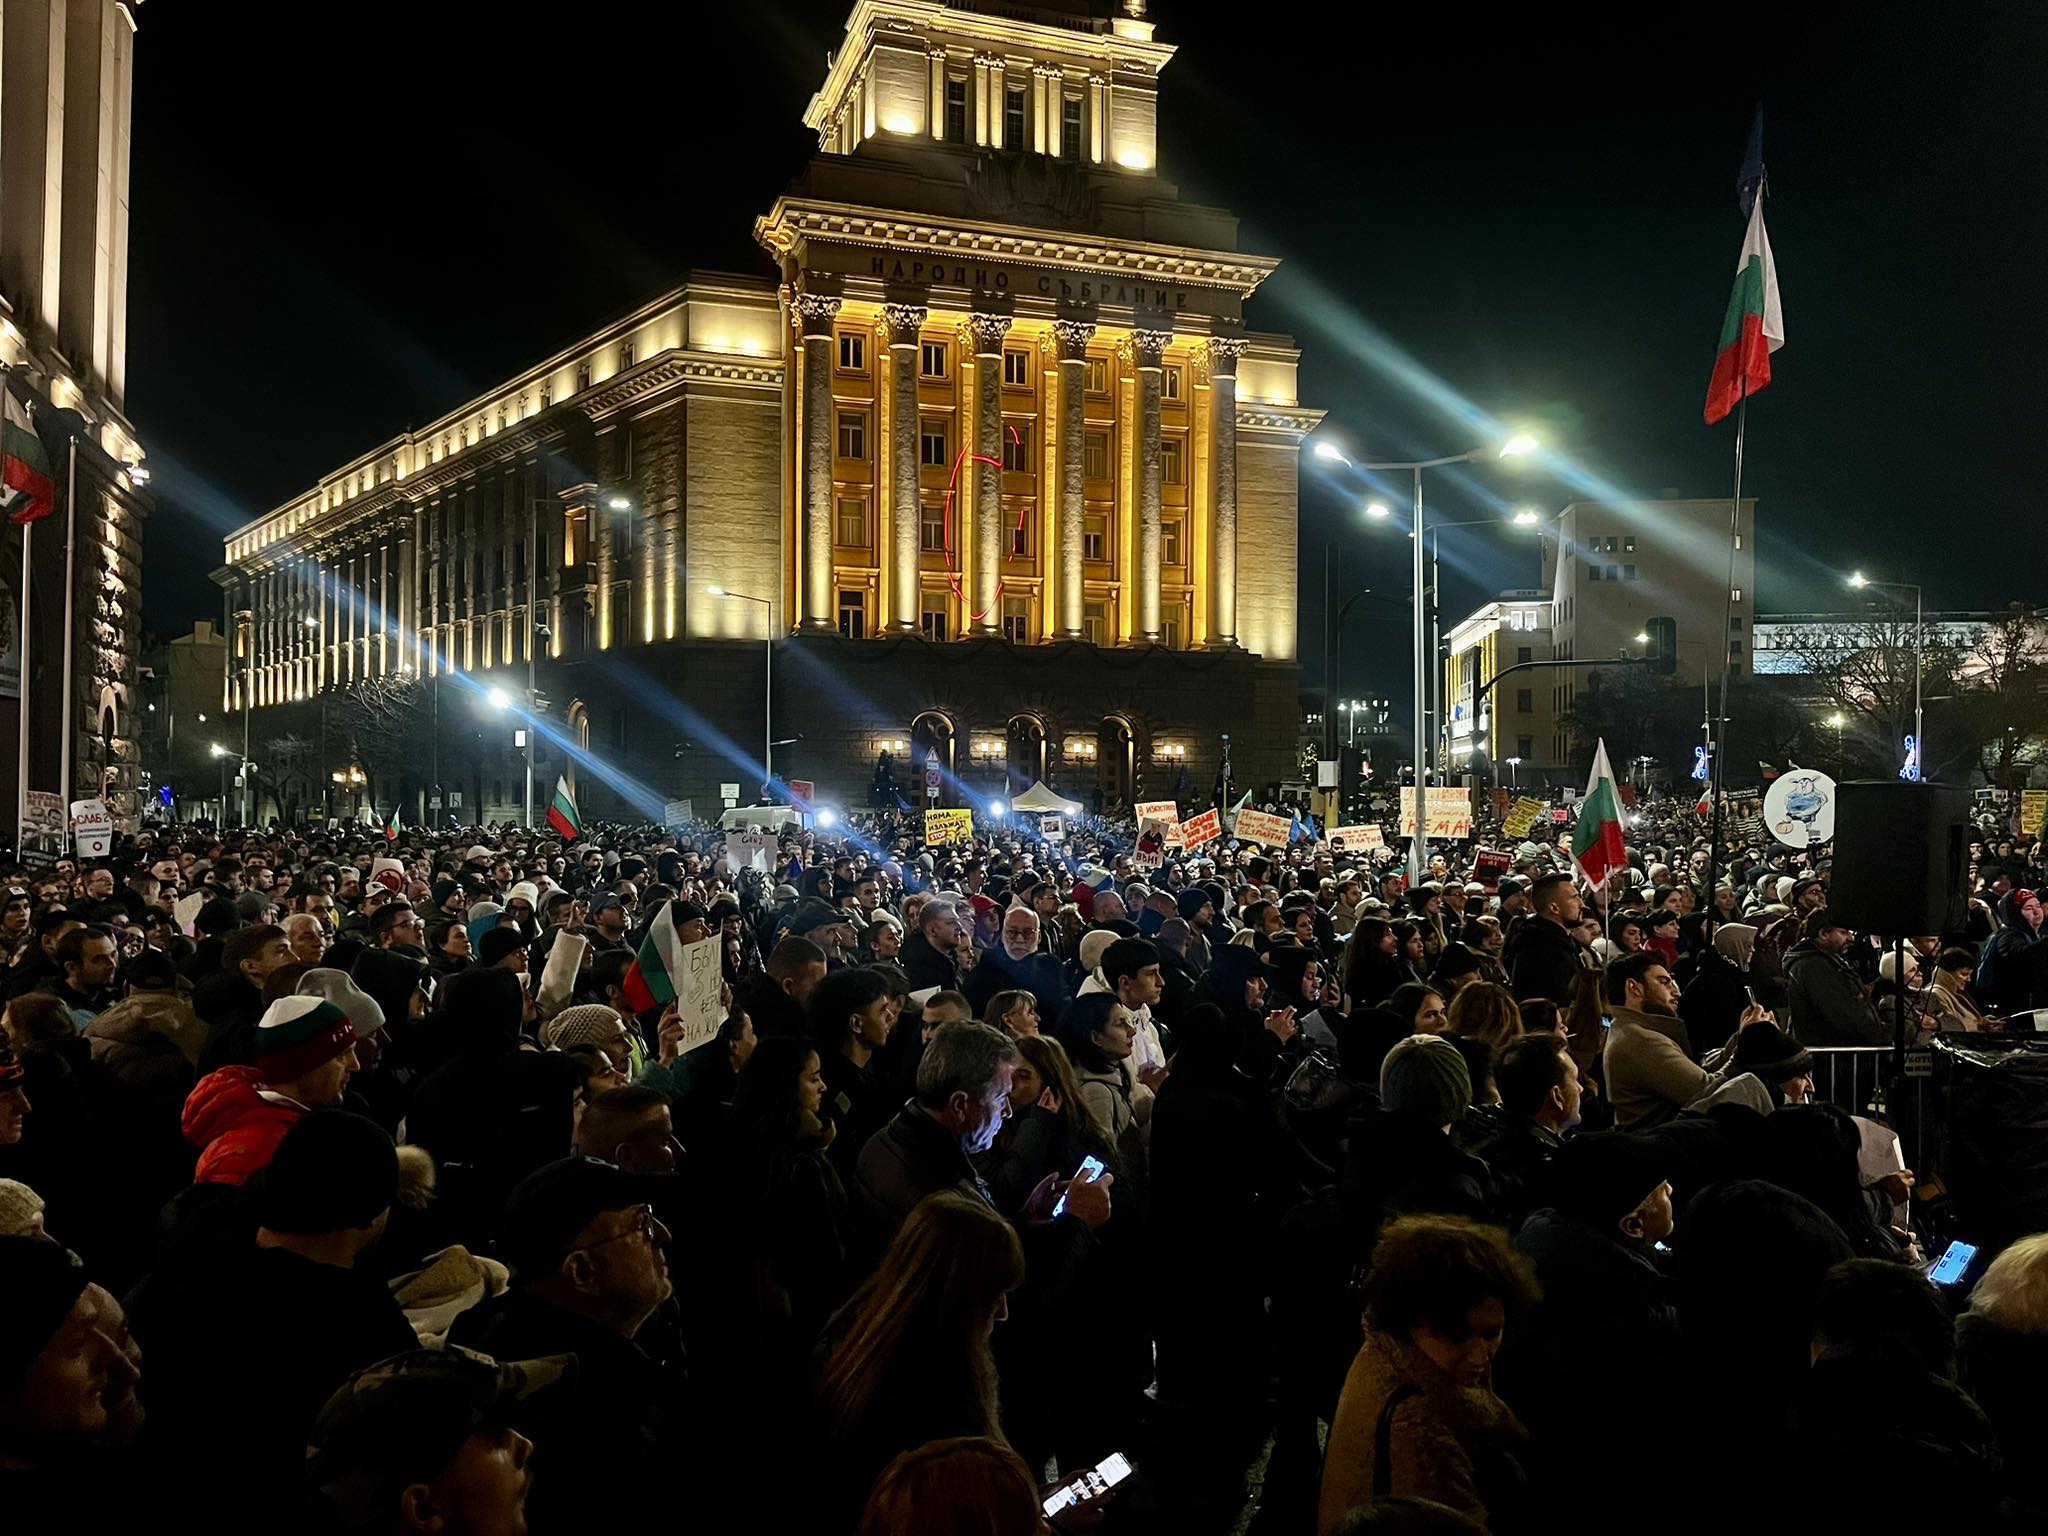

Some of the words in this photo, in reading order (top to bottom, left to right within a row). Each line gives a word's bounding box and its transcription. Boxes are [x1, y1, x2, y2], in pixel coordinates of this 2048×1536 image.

[872, 257, 1009, 289] НАРОДНО
[1038, 276, 1187, 308] СЪБРАНИЕ
[77, 813, 102, 824] СЛАБ
[927, 811, 951, 821] НЯМА
[929, 830, 947, 840] STOP
[1136, 852, 1158, 865] ВЪН!
